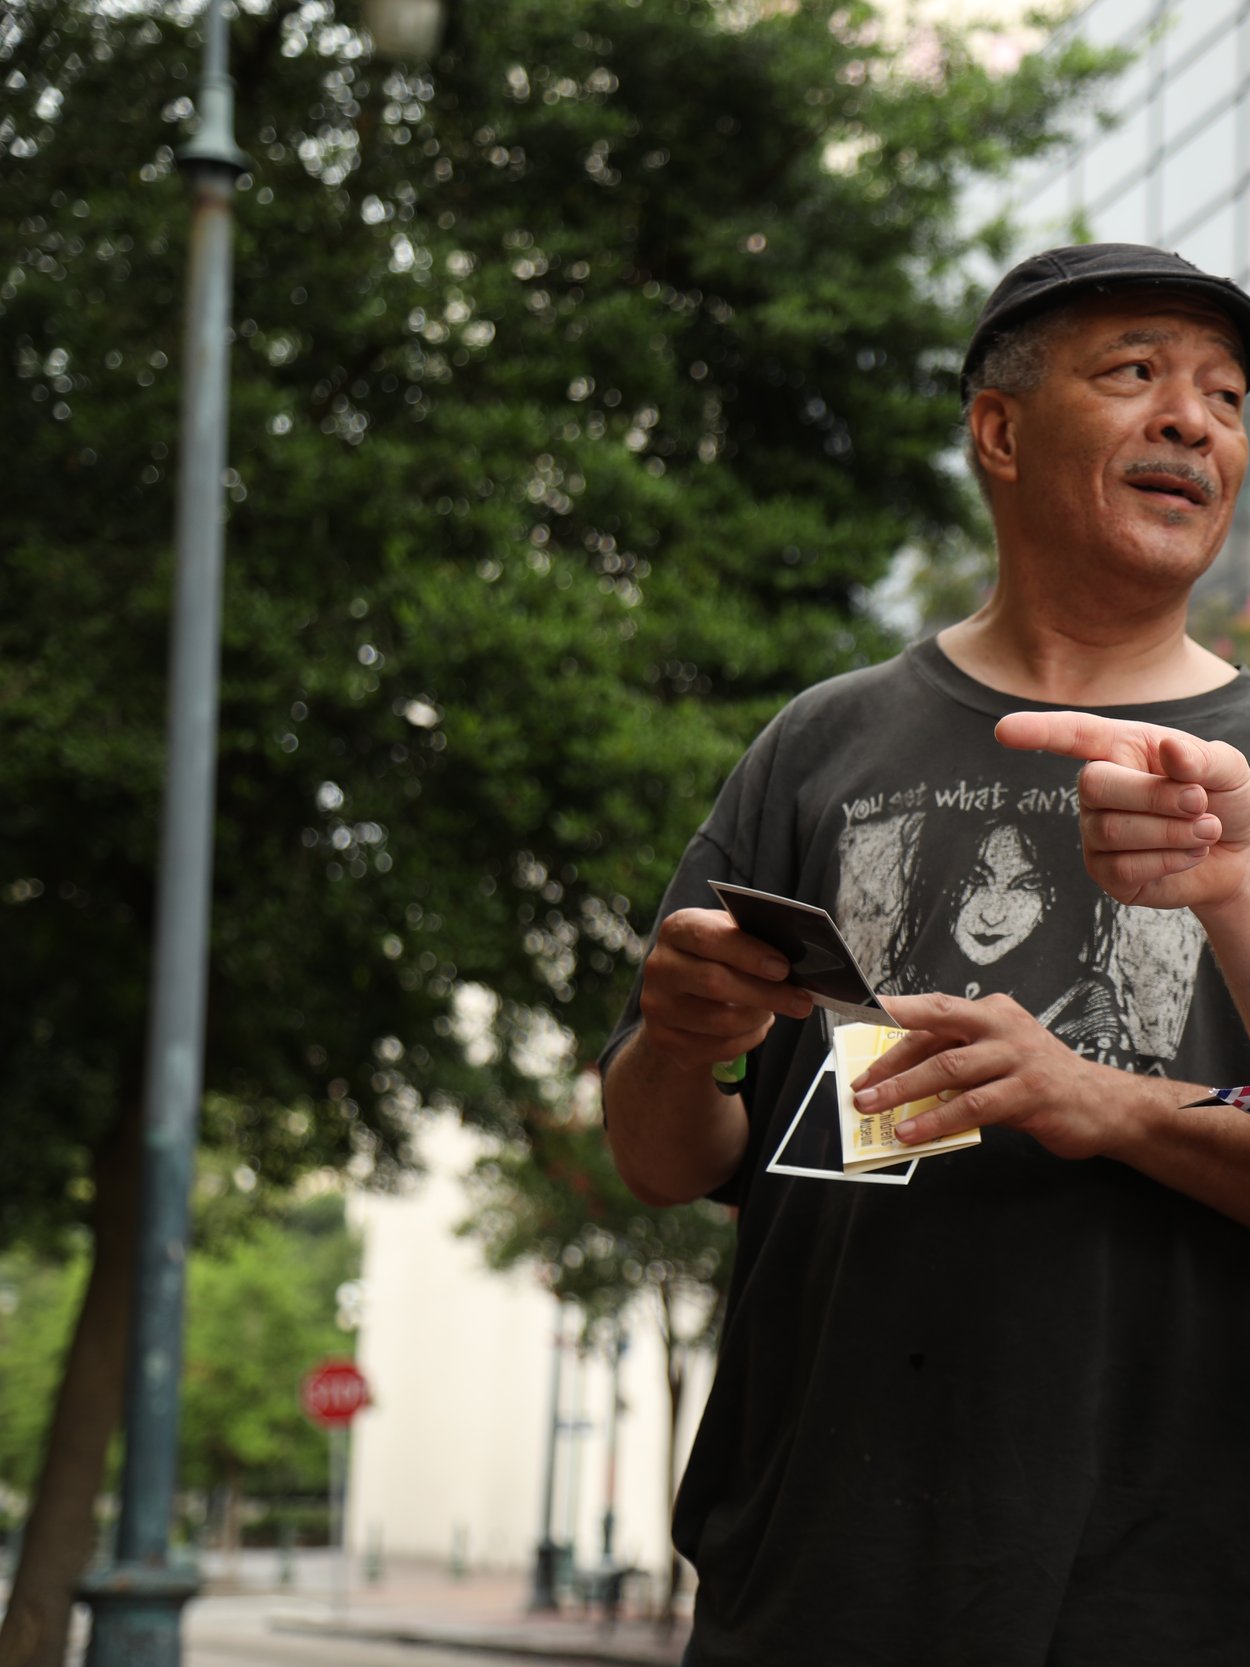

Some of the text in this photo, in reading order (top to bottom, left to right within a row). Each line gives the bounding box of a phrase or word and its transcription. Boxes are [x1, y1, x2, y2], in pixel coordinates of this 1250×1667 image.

[842, 792, 884, 831] YOU
[935, 780, 1009, 811] what
[859, 1116, 874, 1147] Museum
